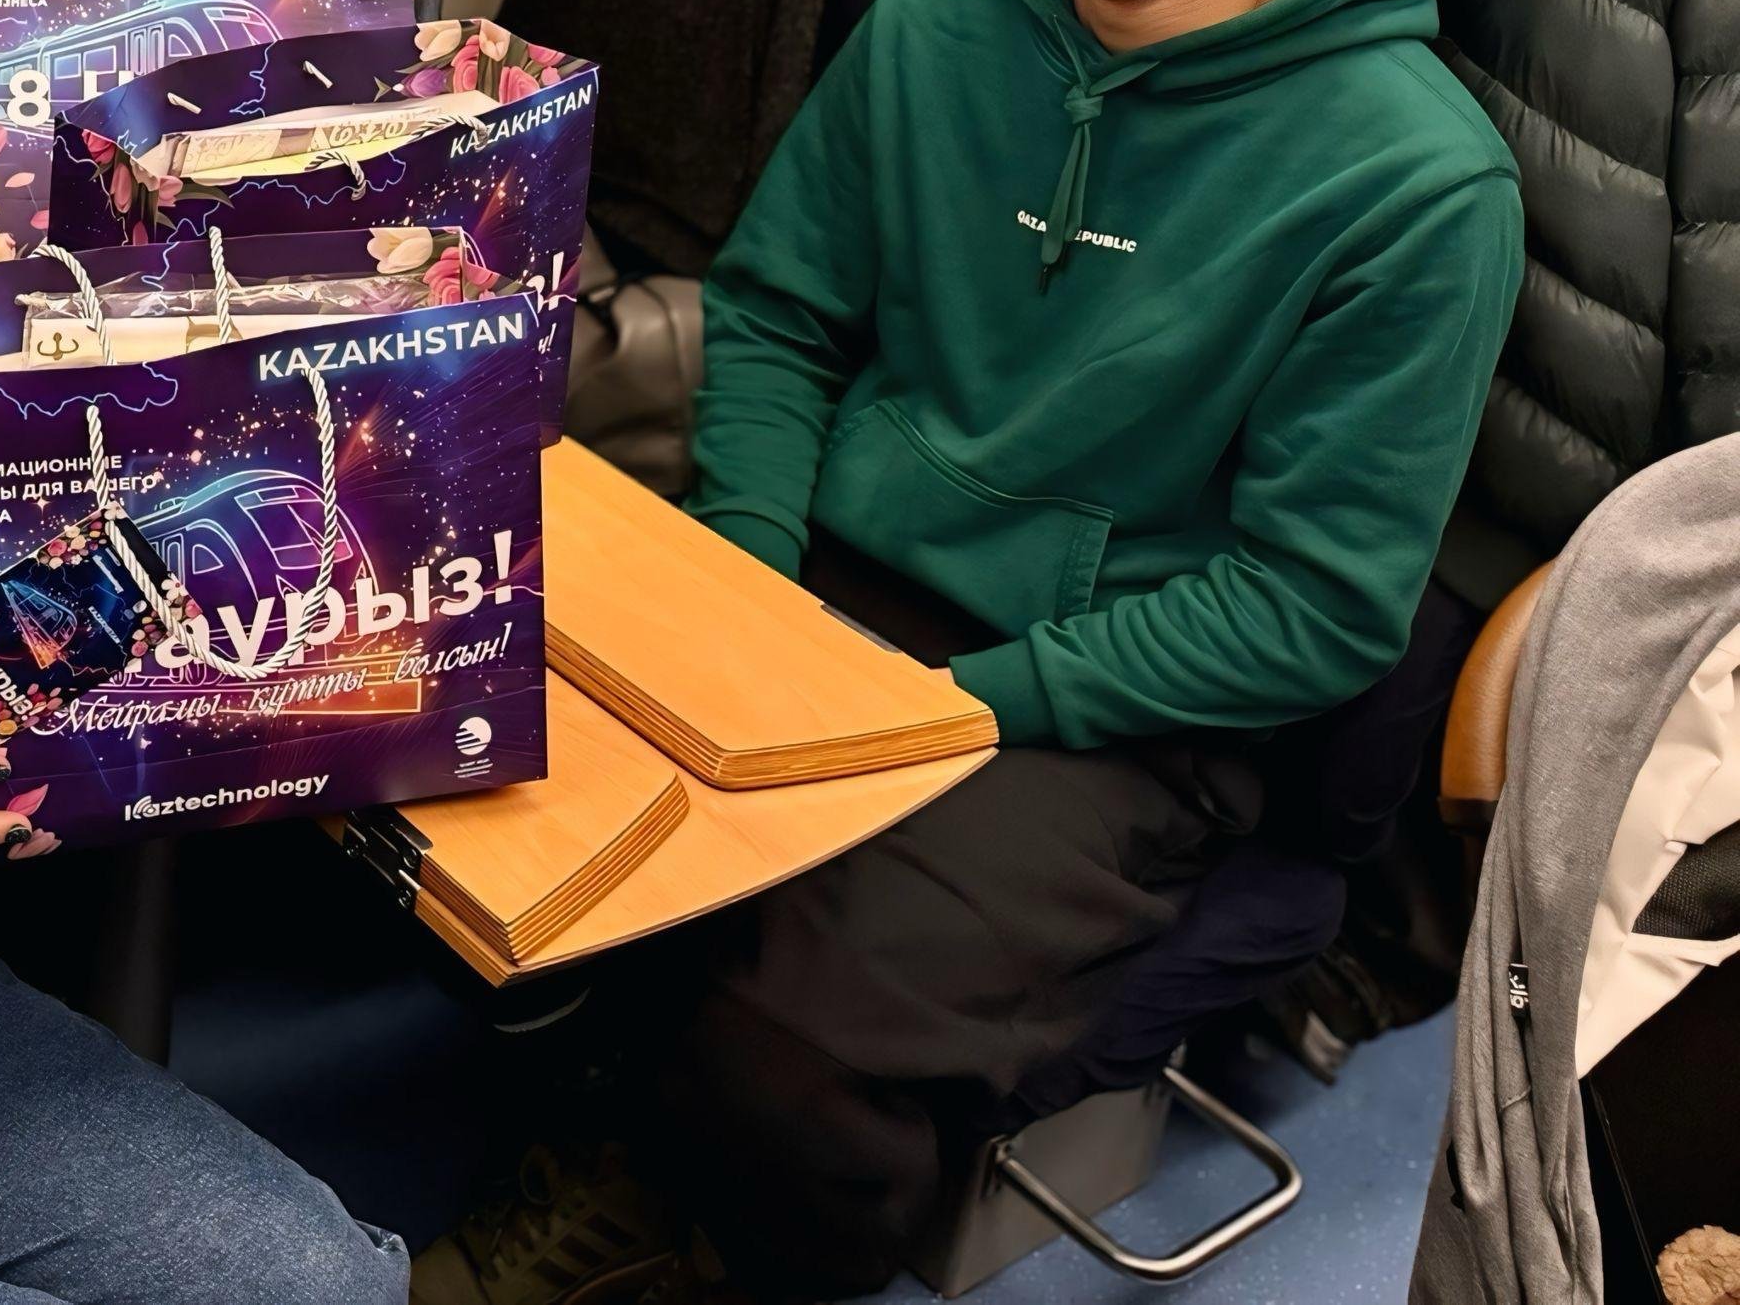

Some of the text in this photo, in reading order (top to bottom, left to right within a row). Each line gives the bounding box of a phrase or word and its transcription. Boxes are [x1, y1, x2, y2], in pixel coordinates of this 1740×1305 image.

[7, 69, 51, 127] 8
[450, 84, 592, 158] KAZAKHSTAN
[1017, 210, 1137, 252] QAZA PUBLIC
[259, 312, 523, 381] KAZAKHSTAN
[23, 481, 63, 501] ДЛЯ
[124, 529, 512, 673] аурыз!
